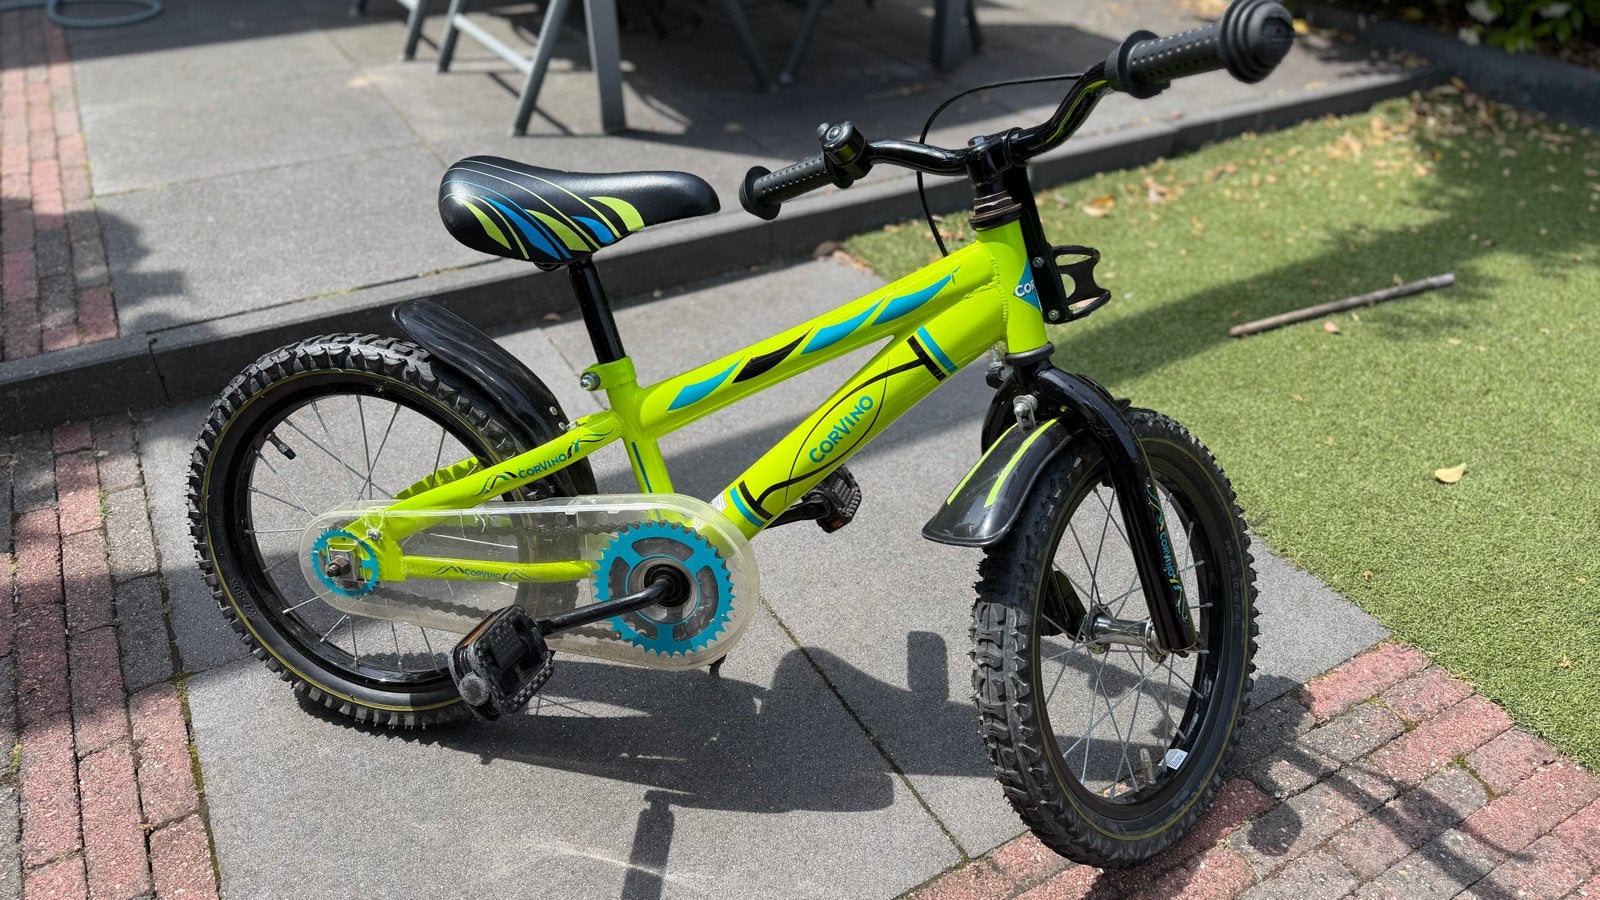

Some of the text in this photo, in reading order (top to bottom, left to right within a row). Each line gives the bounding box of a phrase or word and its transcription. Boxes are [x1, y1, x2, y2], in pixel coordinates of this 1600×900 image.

[808, 395, 874, 463] CORVINO
[518, 453, 567, 479] CORVINO
[1159, 533, 1175, 577] CORVINO
[464, 568, 501, 580] CORVINO
